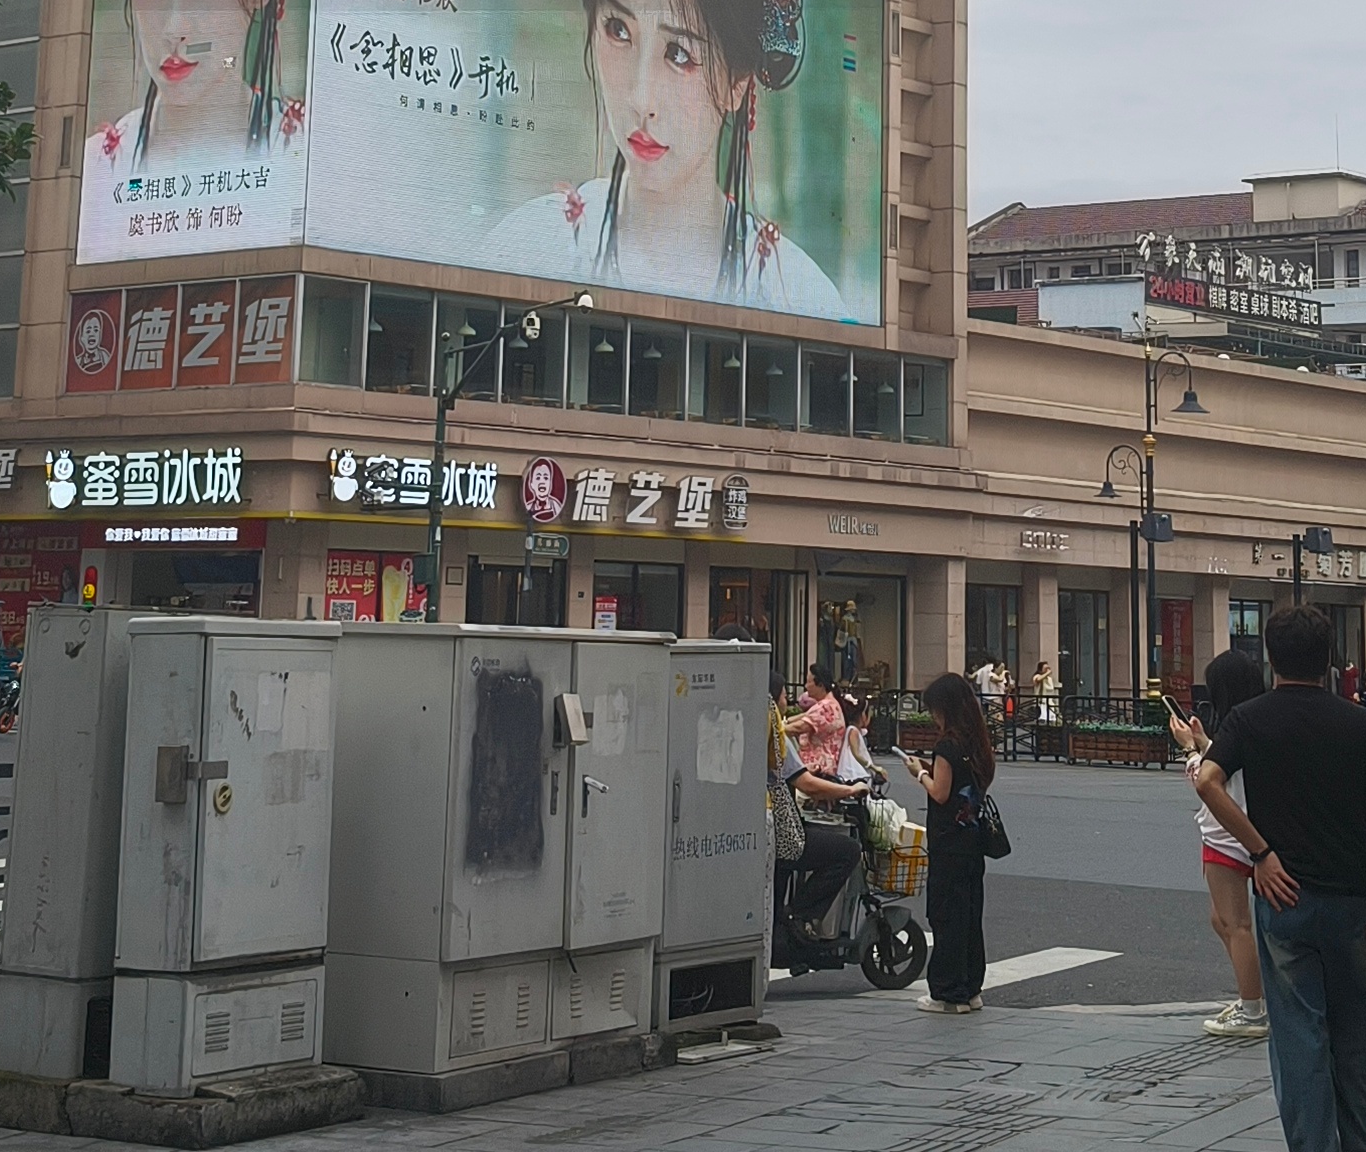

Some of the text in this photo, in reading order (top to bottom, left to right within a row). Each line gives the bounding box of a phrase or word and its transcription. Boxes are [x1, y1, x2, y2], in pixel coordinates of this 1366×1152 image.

[124, 296, 293, 372] 德艺堡
[82, 448, 243, 507] 蜜雪冰城
[573, 468, 715, 529] 德艺堡
[827, 514, 858, 535] WEIR
[328, 559, 376, 576] 扫码点单
[327, 578, 375, 596] 快人一步
[673, 832, 758, 861] 热线电话96371
